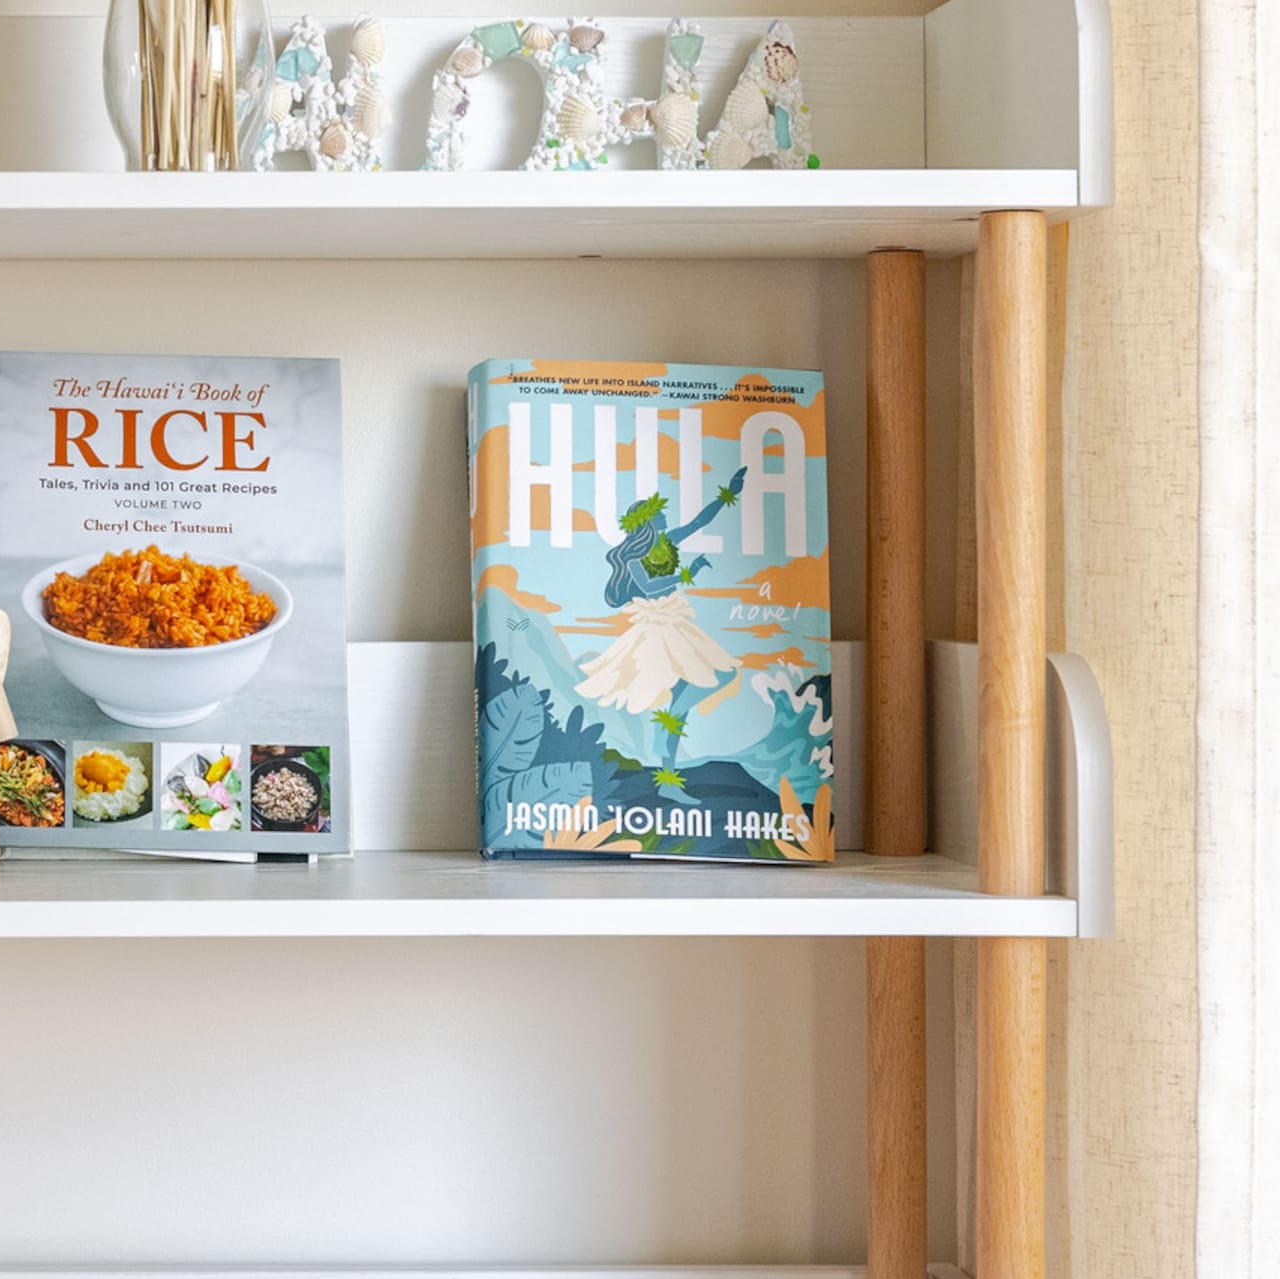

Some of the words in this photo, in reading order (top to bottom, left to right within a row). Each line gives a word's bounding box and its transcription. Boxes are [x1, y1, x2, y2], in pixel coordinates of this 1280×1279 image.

[53, 378, 91, 399] The
[189, 382, 242, 402] Book
[247, 383, 270, 408] of
[519, 386, 531, 394] TO
[534, 387, 559, 395] COME
[702, 393, 739, 402] STRONG
[743, 395, 795, 404] WASHBURN
[602, 378, 624, 386] INTO
[627, 379, 660, 387] ISLAND
[663, 381, 718, 390] NARRATIVES
[753, 384, 805, 394] IMPOSSIBLE
[48, 406, 271, 473] RICE
[39, 478, 78, 491] Tales,
[83, 479, 119, 491] Trivia
[124, 480, 150, 492] and
[154, 481, 175, 492] 101
[179, 482, 217, 493] Great
[222, 483, 278, 495] Recipes
[508, 402, 807, 557] HULA
[114, 500, 168, 510] VOLUME
[172, 501, 203, 510] TWO
[83, 519, 129, 535] Cheryl
[133, 521, 167, 533] Chee
[171, 521, 233, 534] Tsutsumi
[759, 581, 771, 600] a
[729, 601, 801, 622] novel
[504, 802, 598, 836] JASMIN
[723, 810, 811, 842] HAKES
